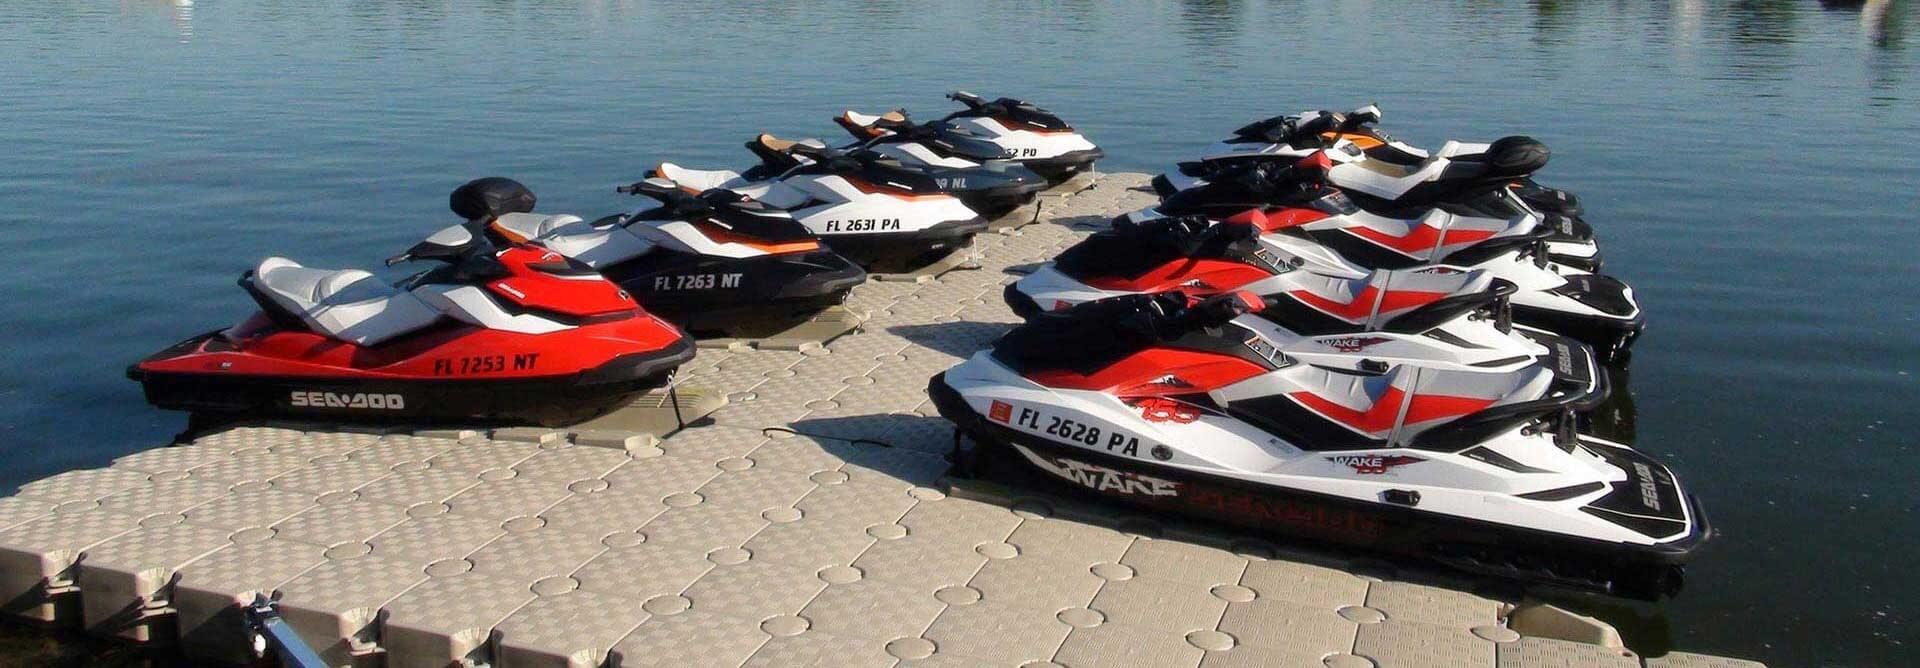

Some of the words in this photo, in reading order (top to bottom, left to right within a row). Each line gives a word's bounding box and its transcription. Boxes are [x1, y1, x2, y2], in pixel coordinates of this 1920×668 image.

[951, 178, 967, 188] NL
[826, 220, 840, 232] FL
[846, 219, 876, 231] 2631
[881, 218, 900, 230] PA
[655, 276, 671, 290] FL
[677, 274, 715, 290] 7263
[721, 273, 743, 288] NT
[1321, 339, 1360, 347] WAKE
[434, 359, 453, 376] FL
[460, 356, 505, 375] 7253
[513, 353, 540, 370] NT
[1018, 407, 1039, 430] FL
[1046, 416, 1100, 446] 2628
[1107, 431, 1139, 457] PA
[1334, 457, 1384, 467] WAKE
[1050, 457, 1180, 497] WAKE
